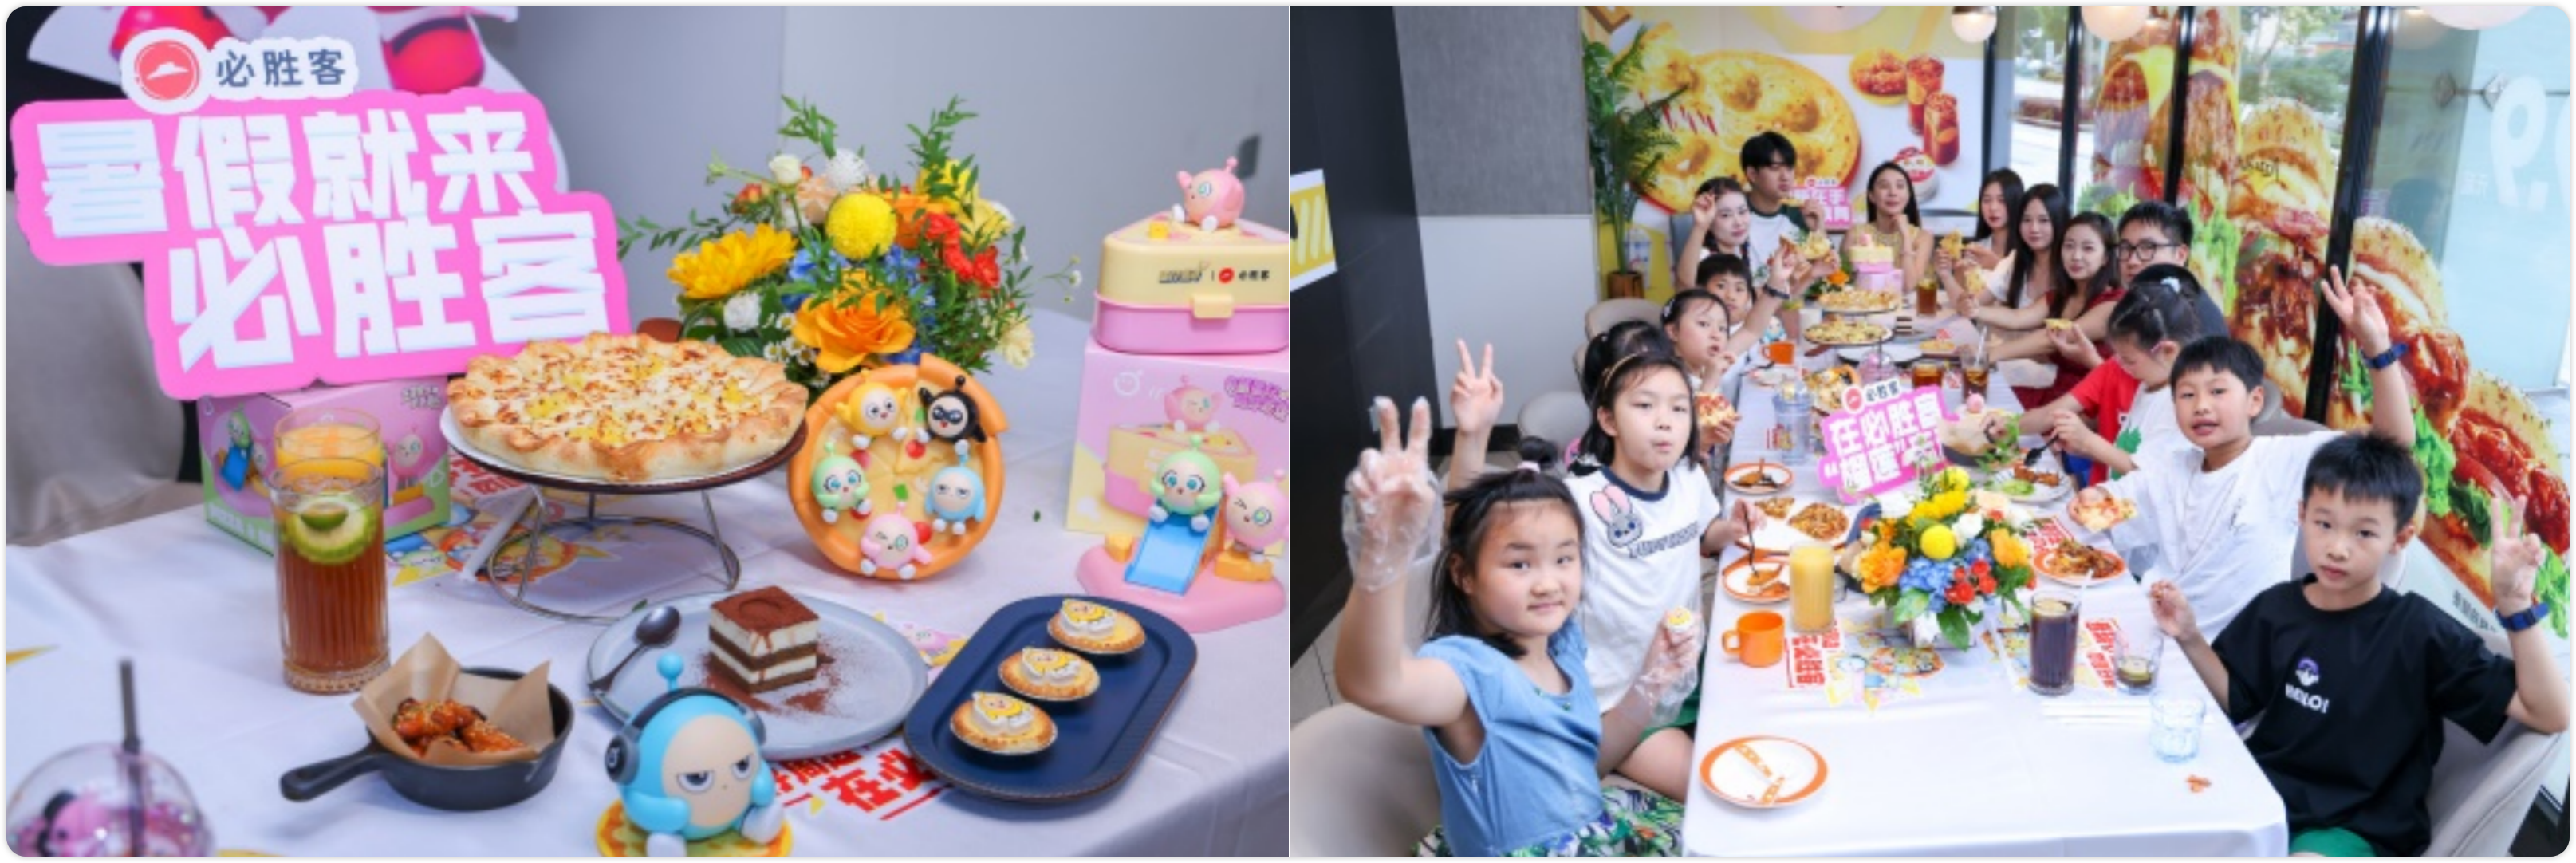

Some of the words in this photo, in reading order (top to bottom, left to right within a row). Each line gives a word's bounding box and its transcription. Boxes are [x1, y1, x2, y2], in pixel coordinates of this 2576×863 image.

[216, 48, 347, 88] 必胜客
[36, 105, 539, 238] 暑假就来
[168, 211, 610, 372] 必胜客
